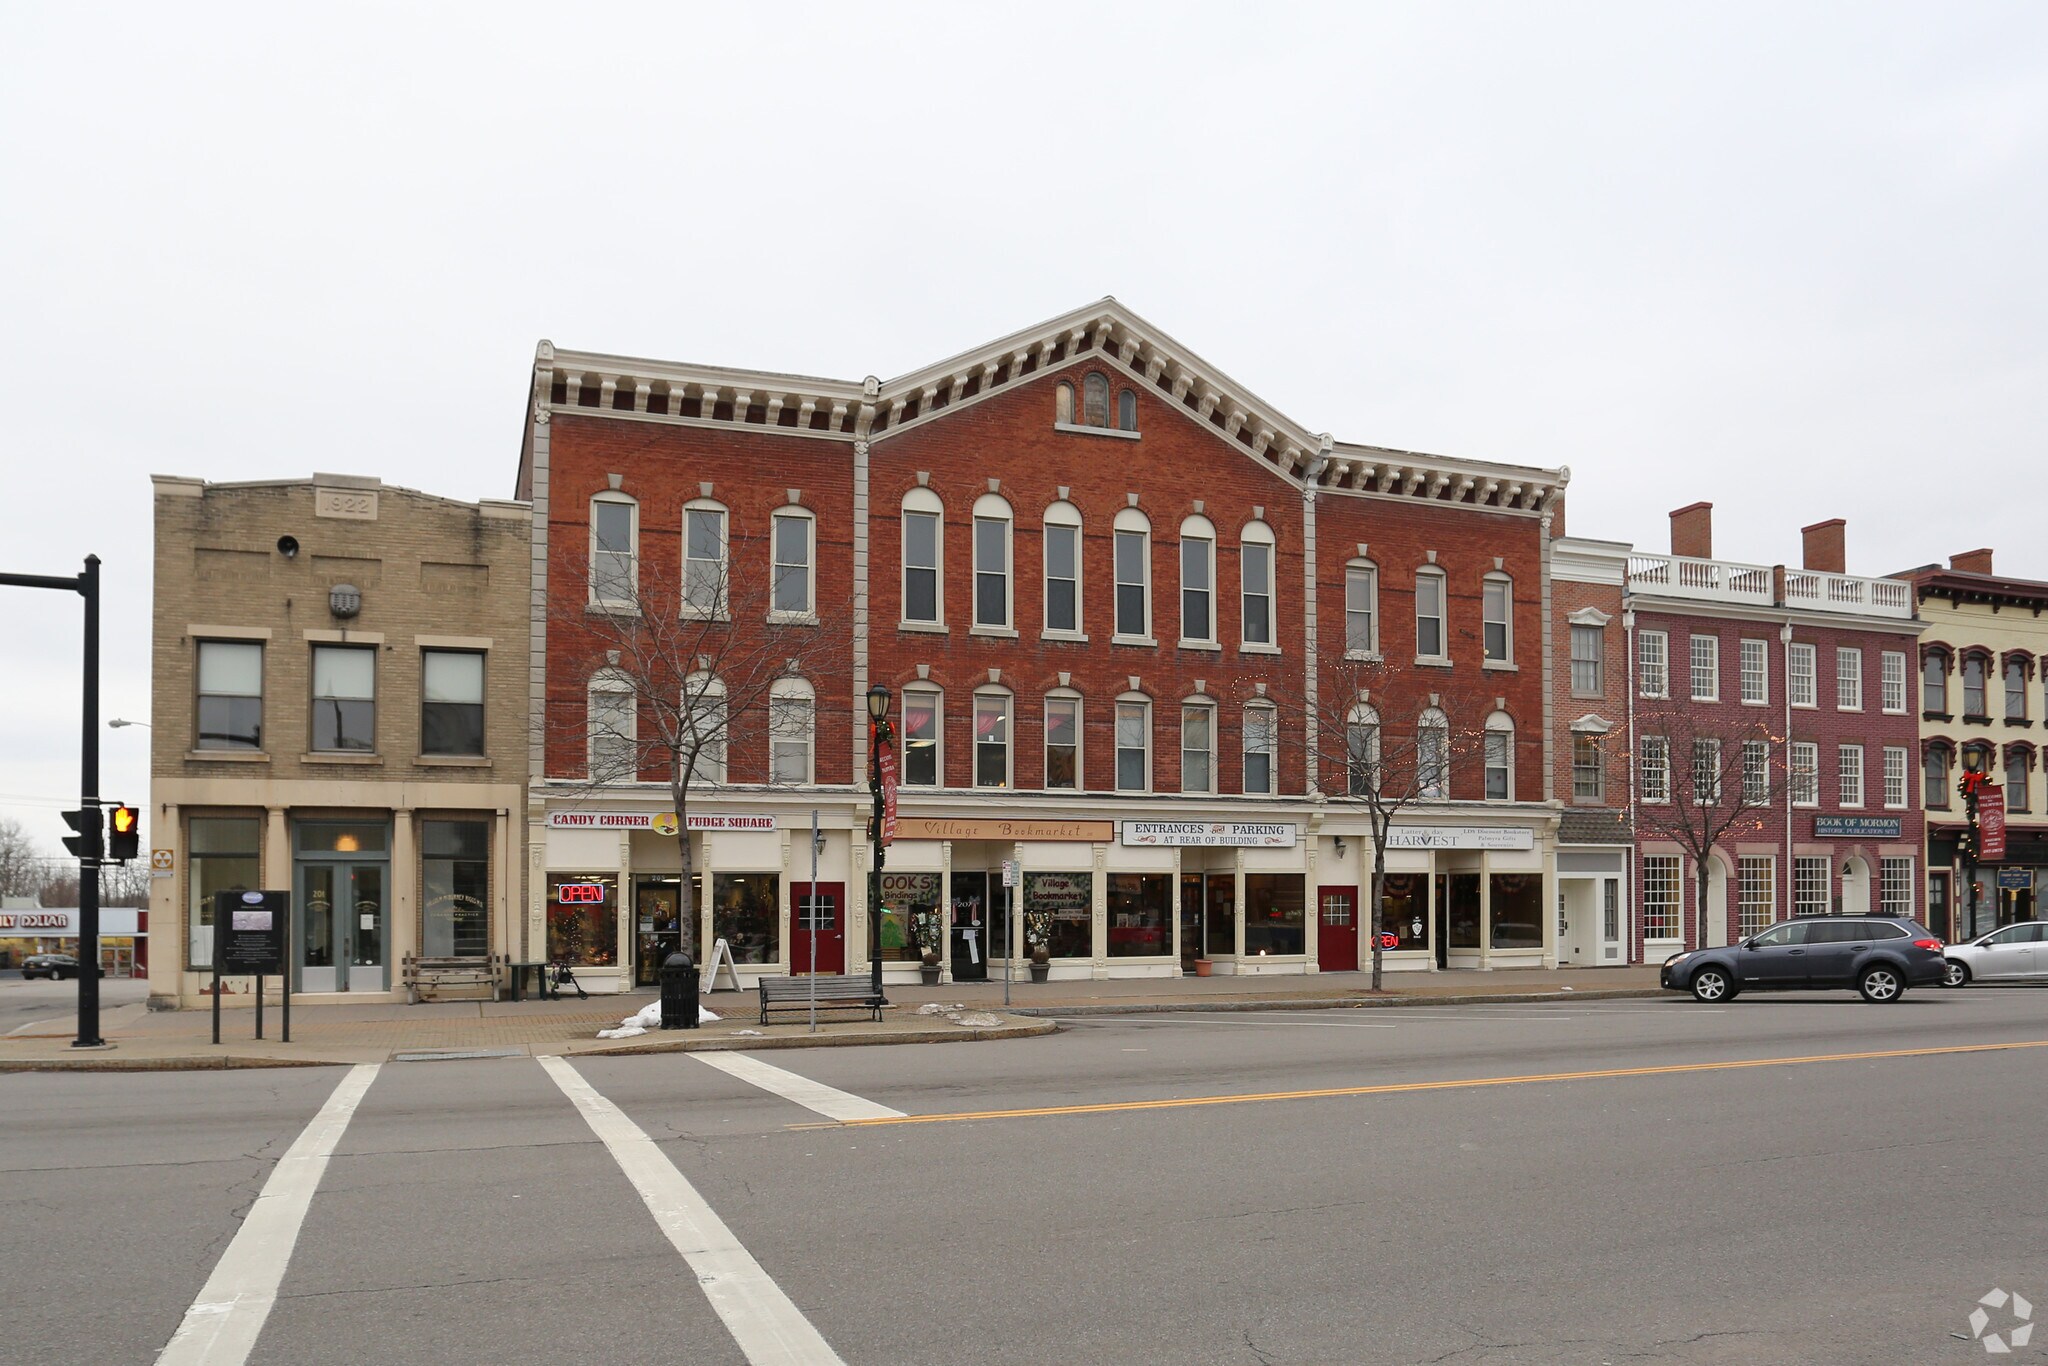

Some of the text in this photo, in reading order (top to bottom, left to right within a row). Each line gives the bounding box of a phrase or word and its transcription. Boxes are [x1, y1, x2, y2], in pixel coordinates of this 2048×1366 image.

[553, 814, 649, 826] CANDY CORNER
[688, 816, 773, 829] FUDGE SQUARE
[1816, 817, 1899, 828] BOOK OF MORMON
[924, 821, 1081, 838] Village Bookmarket
[1135, 823, 1204, 834] ENTRANCES
[1232, 825, 1285, 835] PARKING
[1163, 836, 1259, 845] AT REAR OF BUILDING
[1388, 835, 1460, 847] HARVEST
[883, 876, 931, 890] OOKS
[1041, 879, 1070, 890] Village
[561, 886, 603, 902] OPEN
[884, 891, 918, 900] Bindings
[1033, 891, 1083, 901] Bookmarket
[21, 914, 67, 928] DOLLAR
